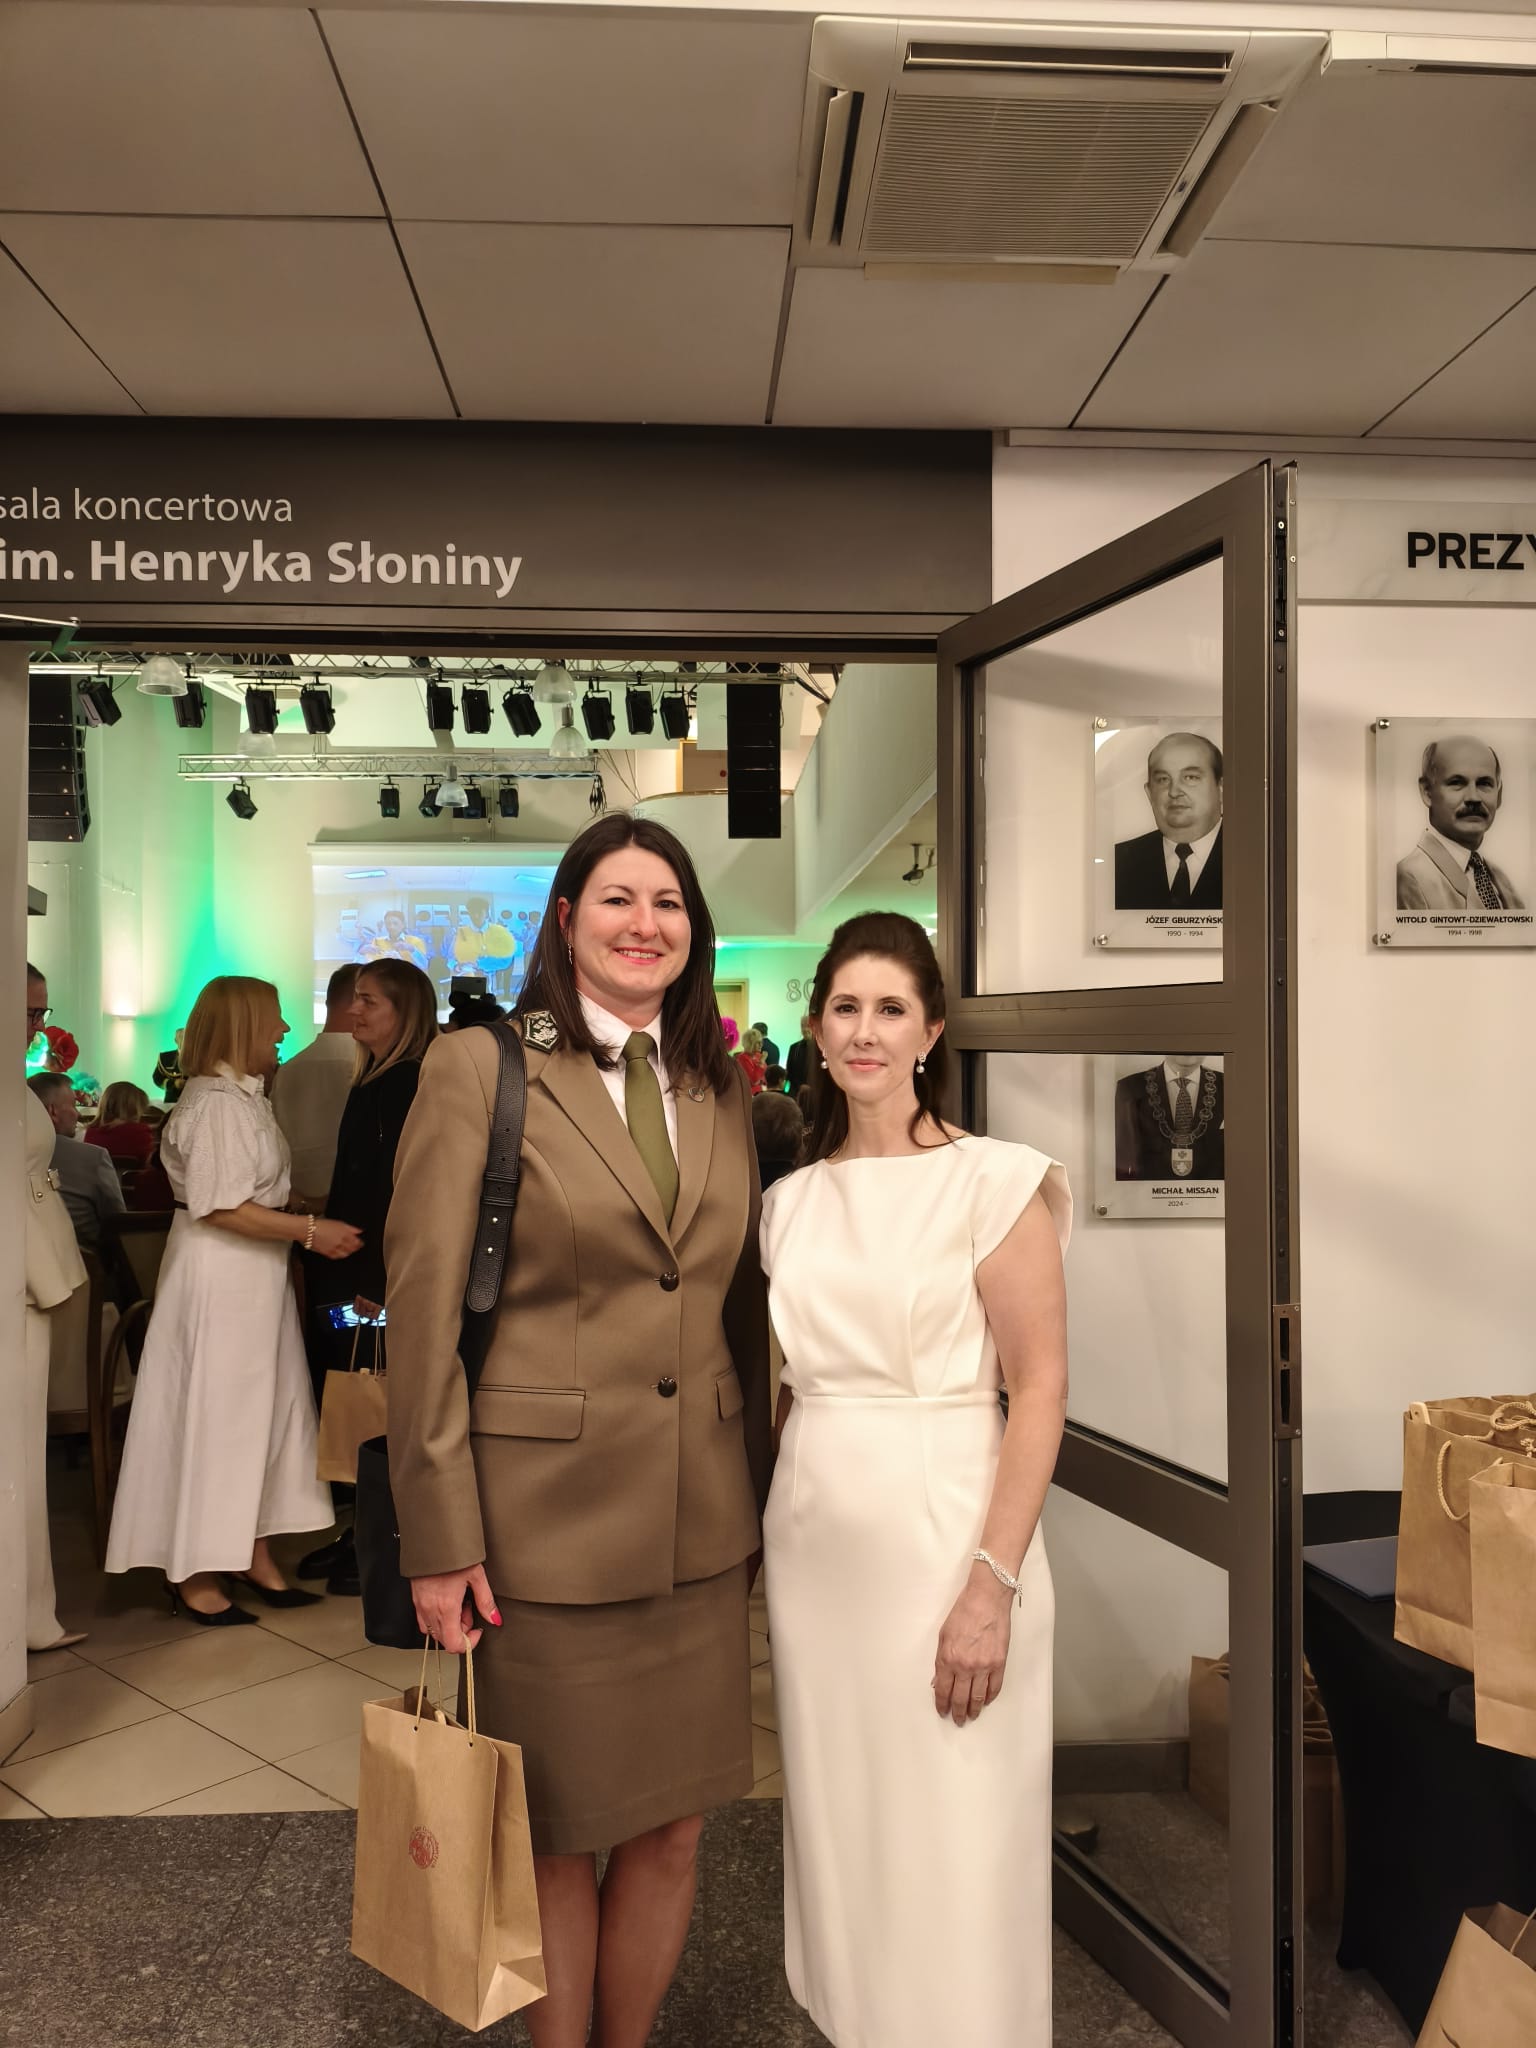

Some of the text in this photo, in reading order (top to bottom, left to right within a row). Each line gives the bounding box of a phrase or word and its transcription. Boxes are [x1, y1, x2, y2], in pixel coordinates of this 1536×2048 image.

[74, 487, 294, 523] koncertowa
[90, 539, 312, 594] Henryka
[326, 541, 523, 599] Słoniny
[1145, 915, 1169, 924] JÓZEF
[1396, 916, 1427, 924] WITOLD
[1152, 1187, 1184, 1195] MICHAŁ
